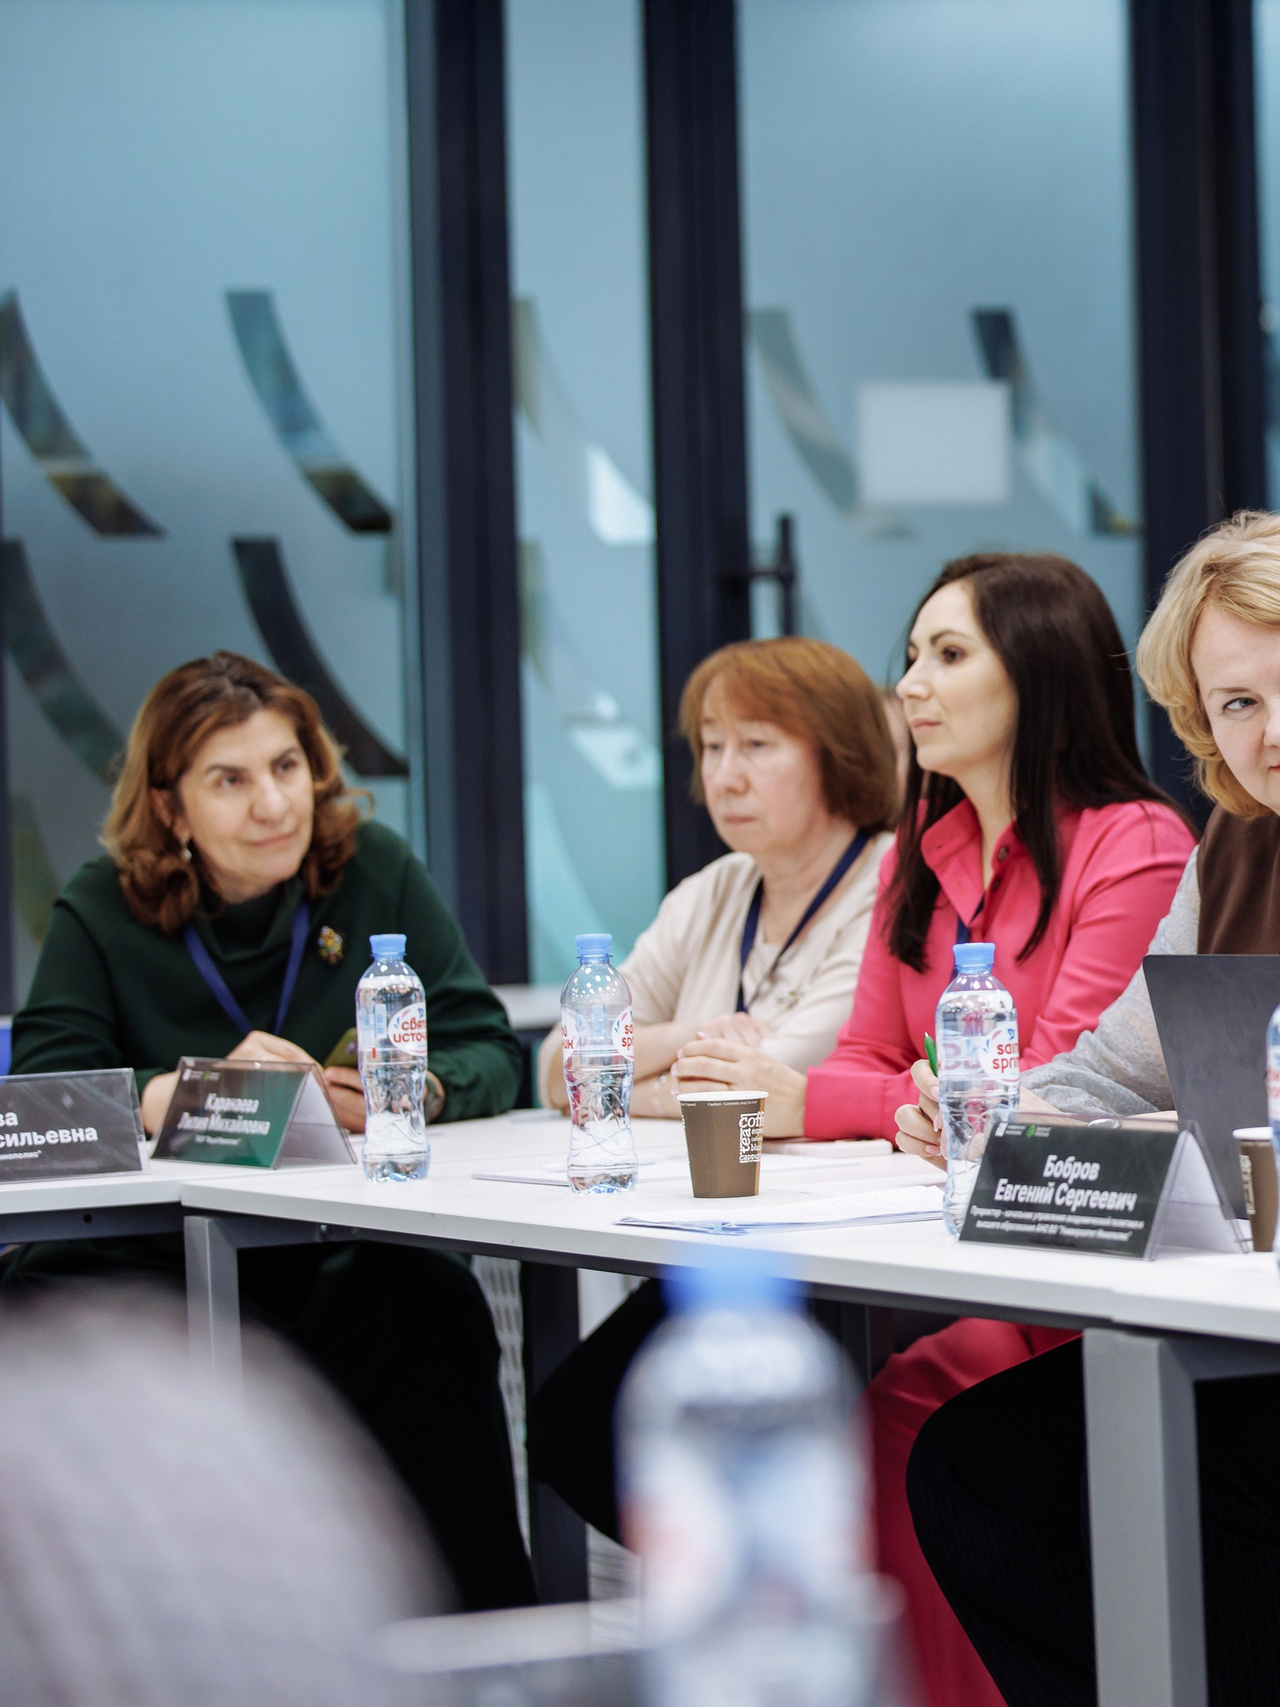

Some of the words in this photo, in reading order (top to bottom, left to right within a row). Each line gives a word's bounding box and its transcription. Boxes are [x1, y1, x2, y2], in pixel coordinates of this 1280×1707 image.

[1042, 1154, 1101, 1185] Бобров
[994, 1178, 1055, 1202] Евгений
[1055, 1182, 1138, 1213] Сергеевич
